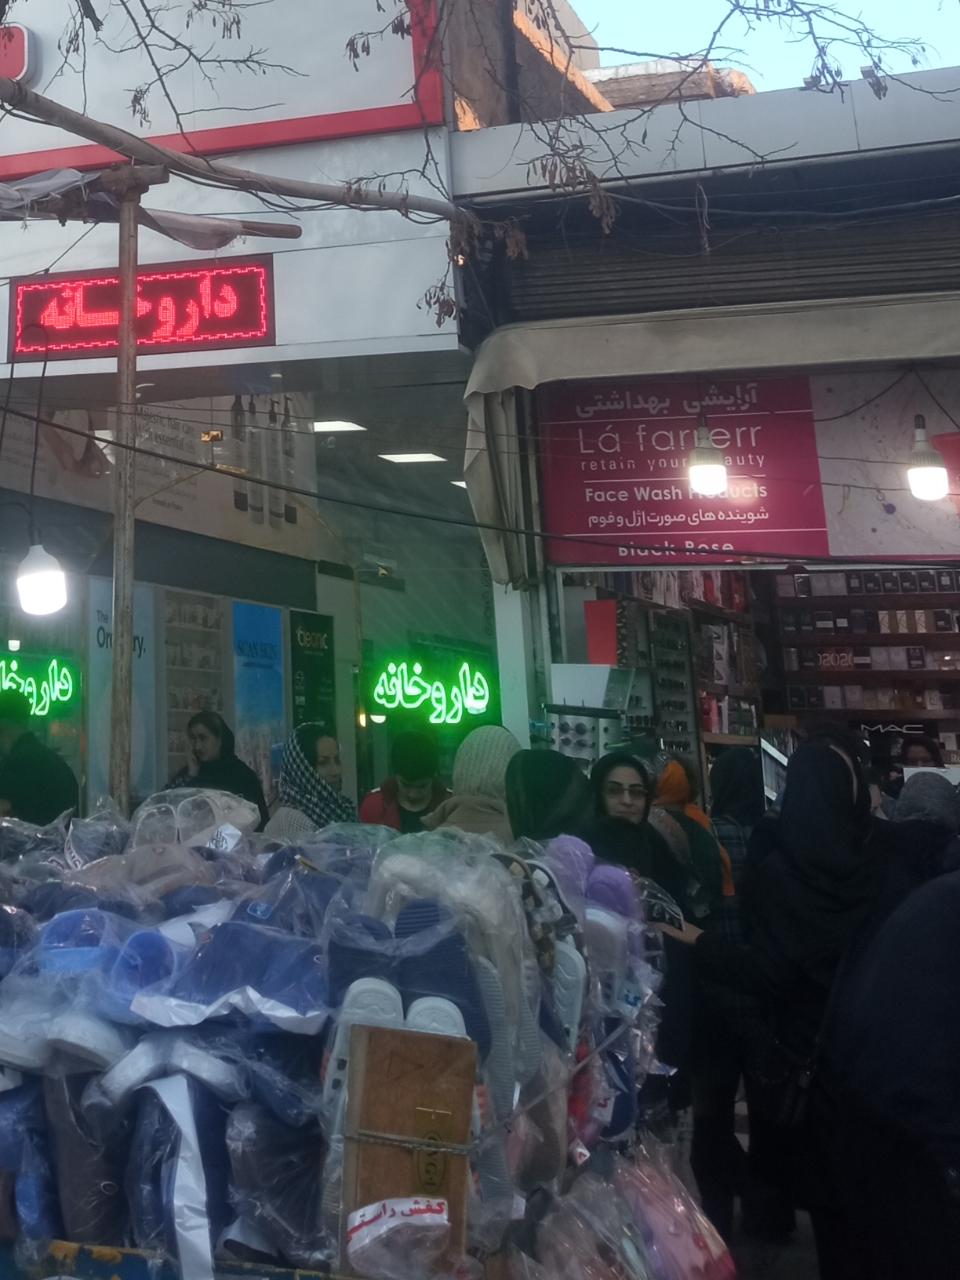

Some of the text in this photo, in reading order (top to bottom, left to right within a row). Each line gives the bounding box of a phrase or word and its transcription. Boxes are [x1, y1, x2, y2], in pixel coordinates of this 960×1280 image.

[576, 382, 758, 418] آرایشی بهداشتی
[581, 453, 765, 471] retain your auty
[585, 488, 629, 502] Face
[634, 485, 683, 502] Wash
[587, 511, 616, 528] فوم
[646, 513, 686, 527] صورت
[717, 507, 769, 524] شوینده
[373, 661, 490, 724] داروخانه
[861, 724, 925, 734] MAC
[400, 1198, 446, 1217] کفش
